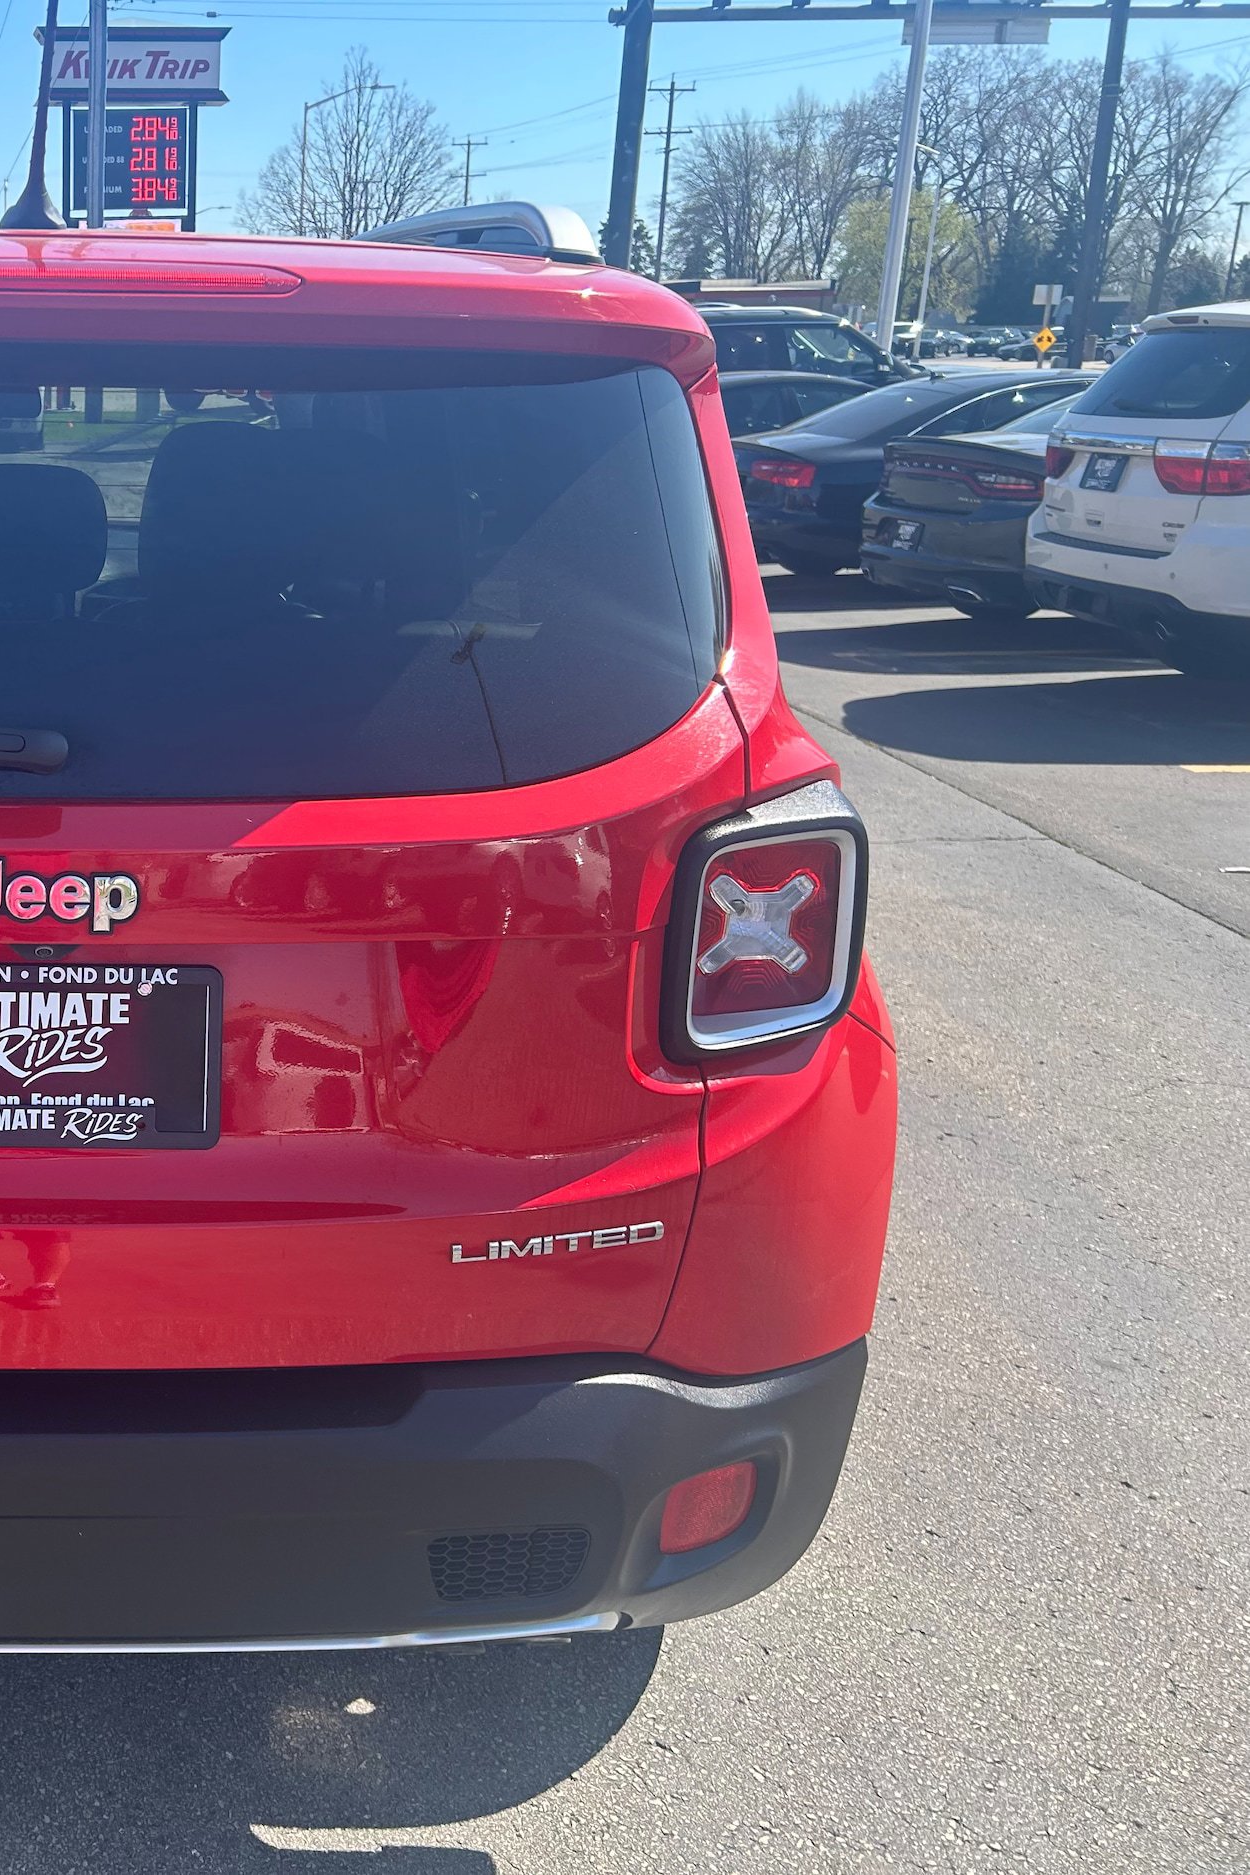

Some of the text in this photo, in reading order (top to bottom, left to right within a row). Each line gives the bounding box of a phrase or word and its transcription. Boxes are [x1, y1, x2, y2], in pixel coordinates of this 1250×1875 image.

[145, 50, 210, 79] TRIP
[38, 966, 98, 984] FOND
[104, 968, 134, 985] DU
[141, 968, 179, 985] LAC
[451, 1220, 665, 1264] LIMITED
